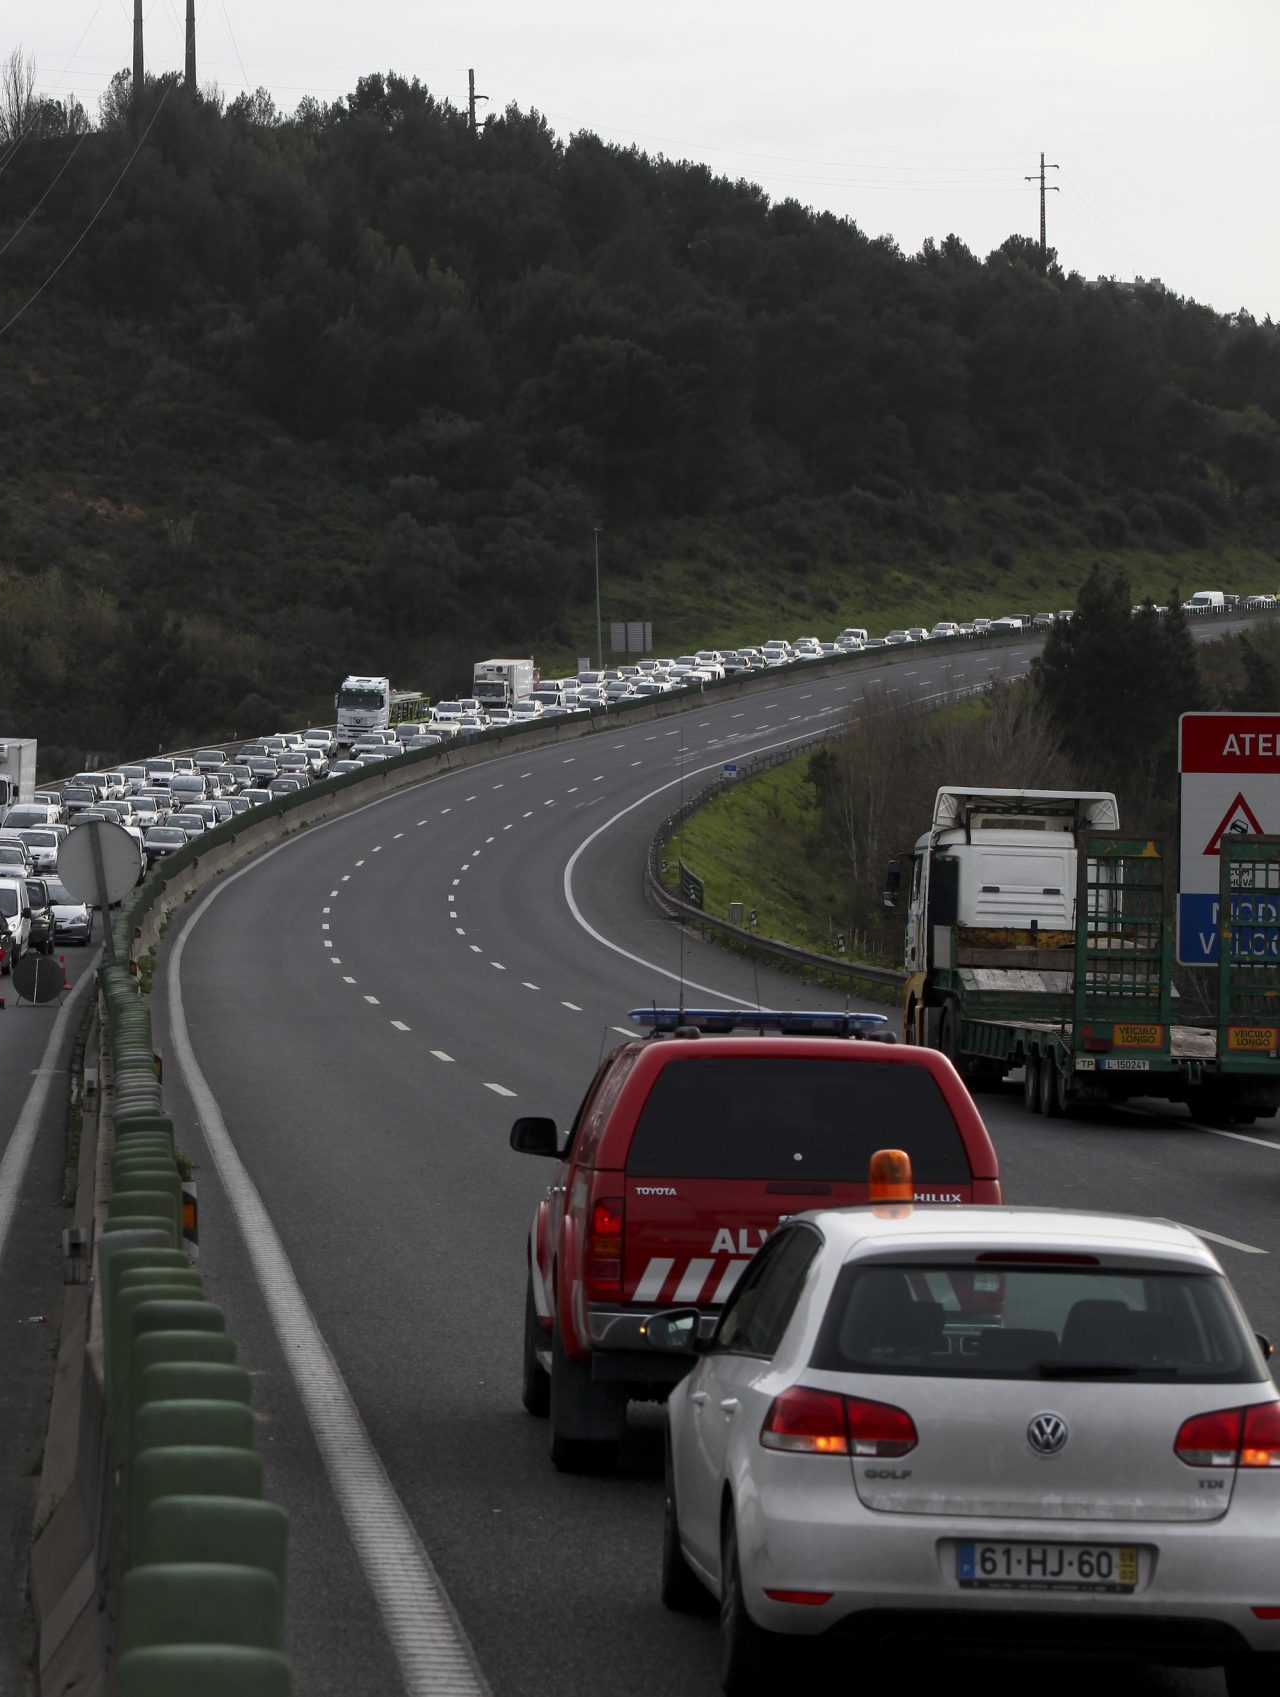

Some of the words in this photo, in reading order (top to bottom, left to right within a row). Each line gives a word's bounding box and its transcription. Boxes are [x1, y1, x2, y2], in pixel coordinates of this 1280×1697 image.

[1222, 733, 1280, 756] ATE
[1121, 1035, 1156, 1044] LONGO
[1236, 1038, 1271, 1047] LONGO
[635, 1187, 677, 1196] TOYOTA
[913, 1193, 962, 1202] HILUX
[864, 1469, 912, 1480] GOLF
[1197, 1479, 1225, 1489] TDI
